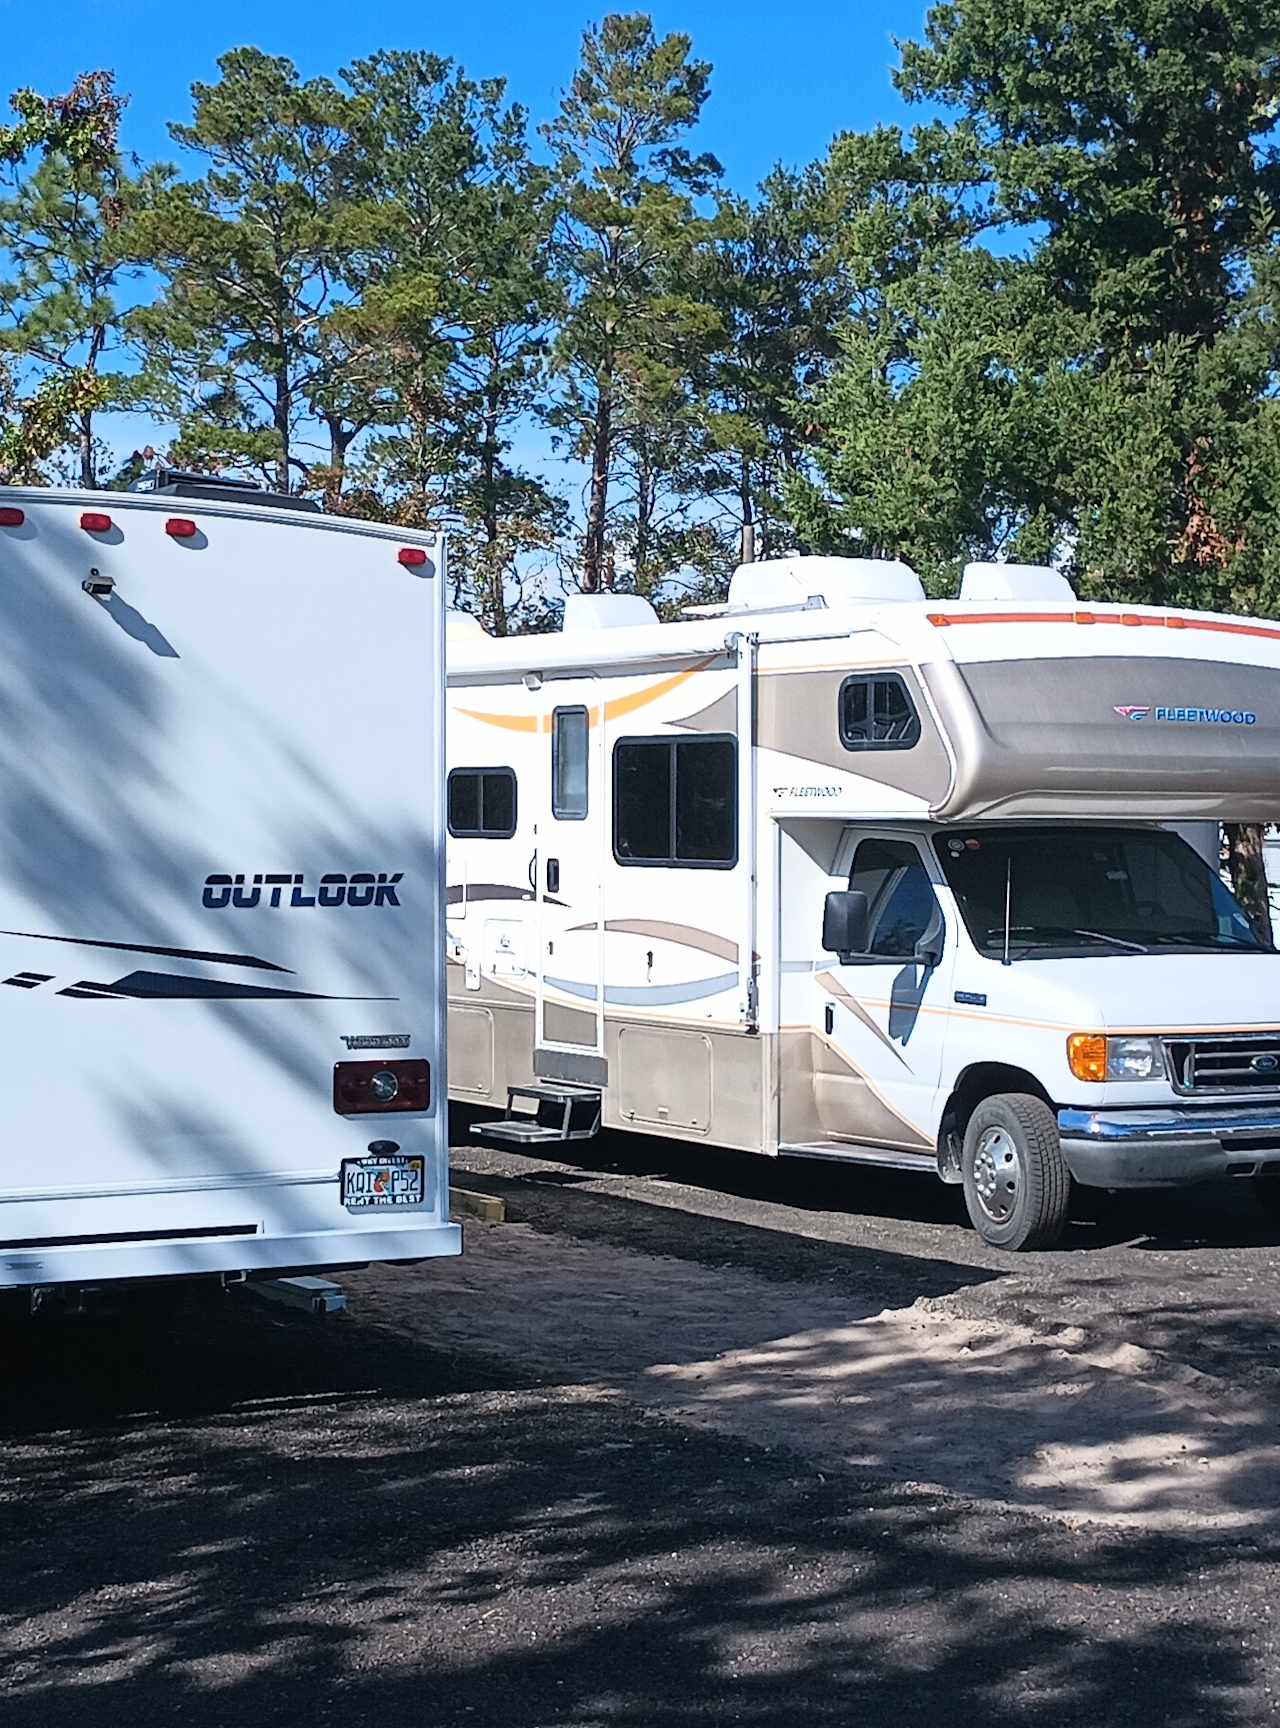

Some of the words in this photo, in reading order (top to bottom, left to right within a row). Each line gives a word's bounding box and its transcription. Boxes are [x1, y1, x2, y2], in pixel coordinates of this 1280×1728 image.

[1154, 706, 1257, 726] FLEETWOOD
[202, 872, 405, 909] OUTLOOK
[391, 1169, 419, 1193] P52
[373, 1195, 393, 1205] THE
